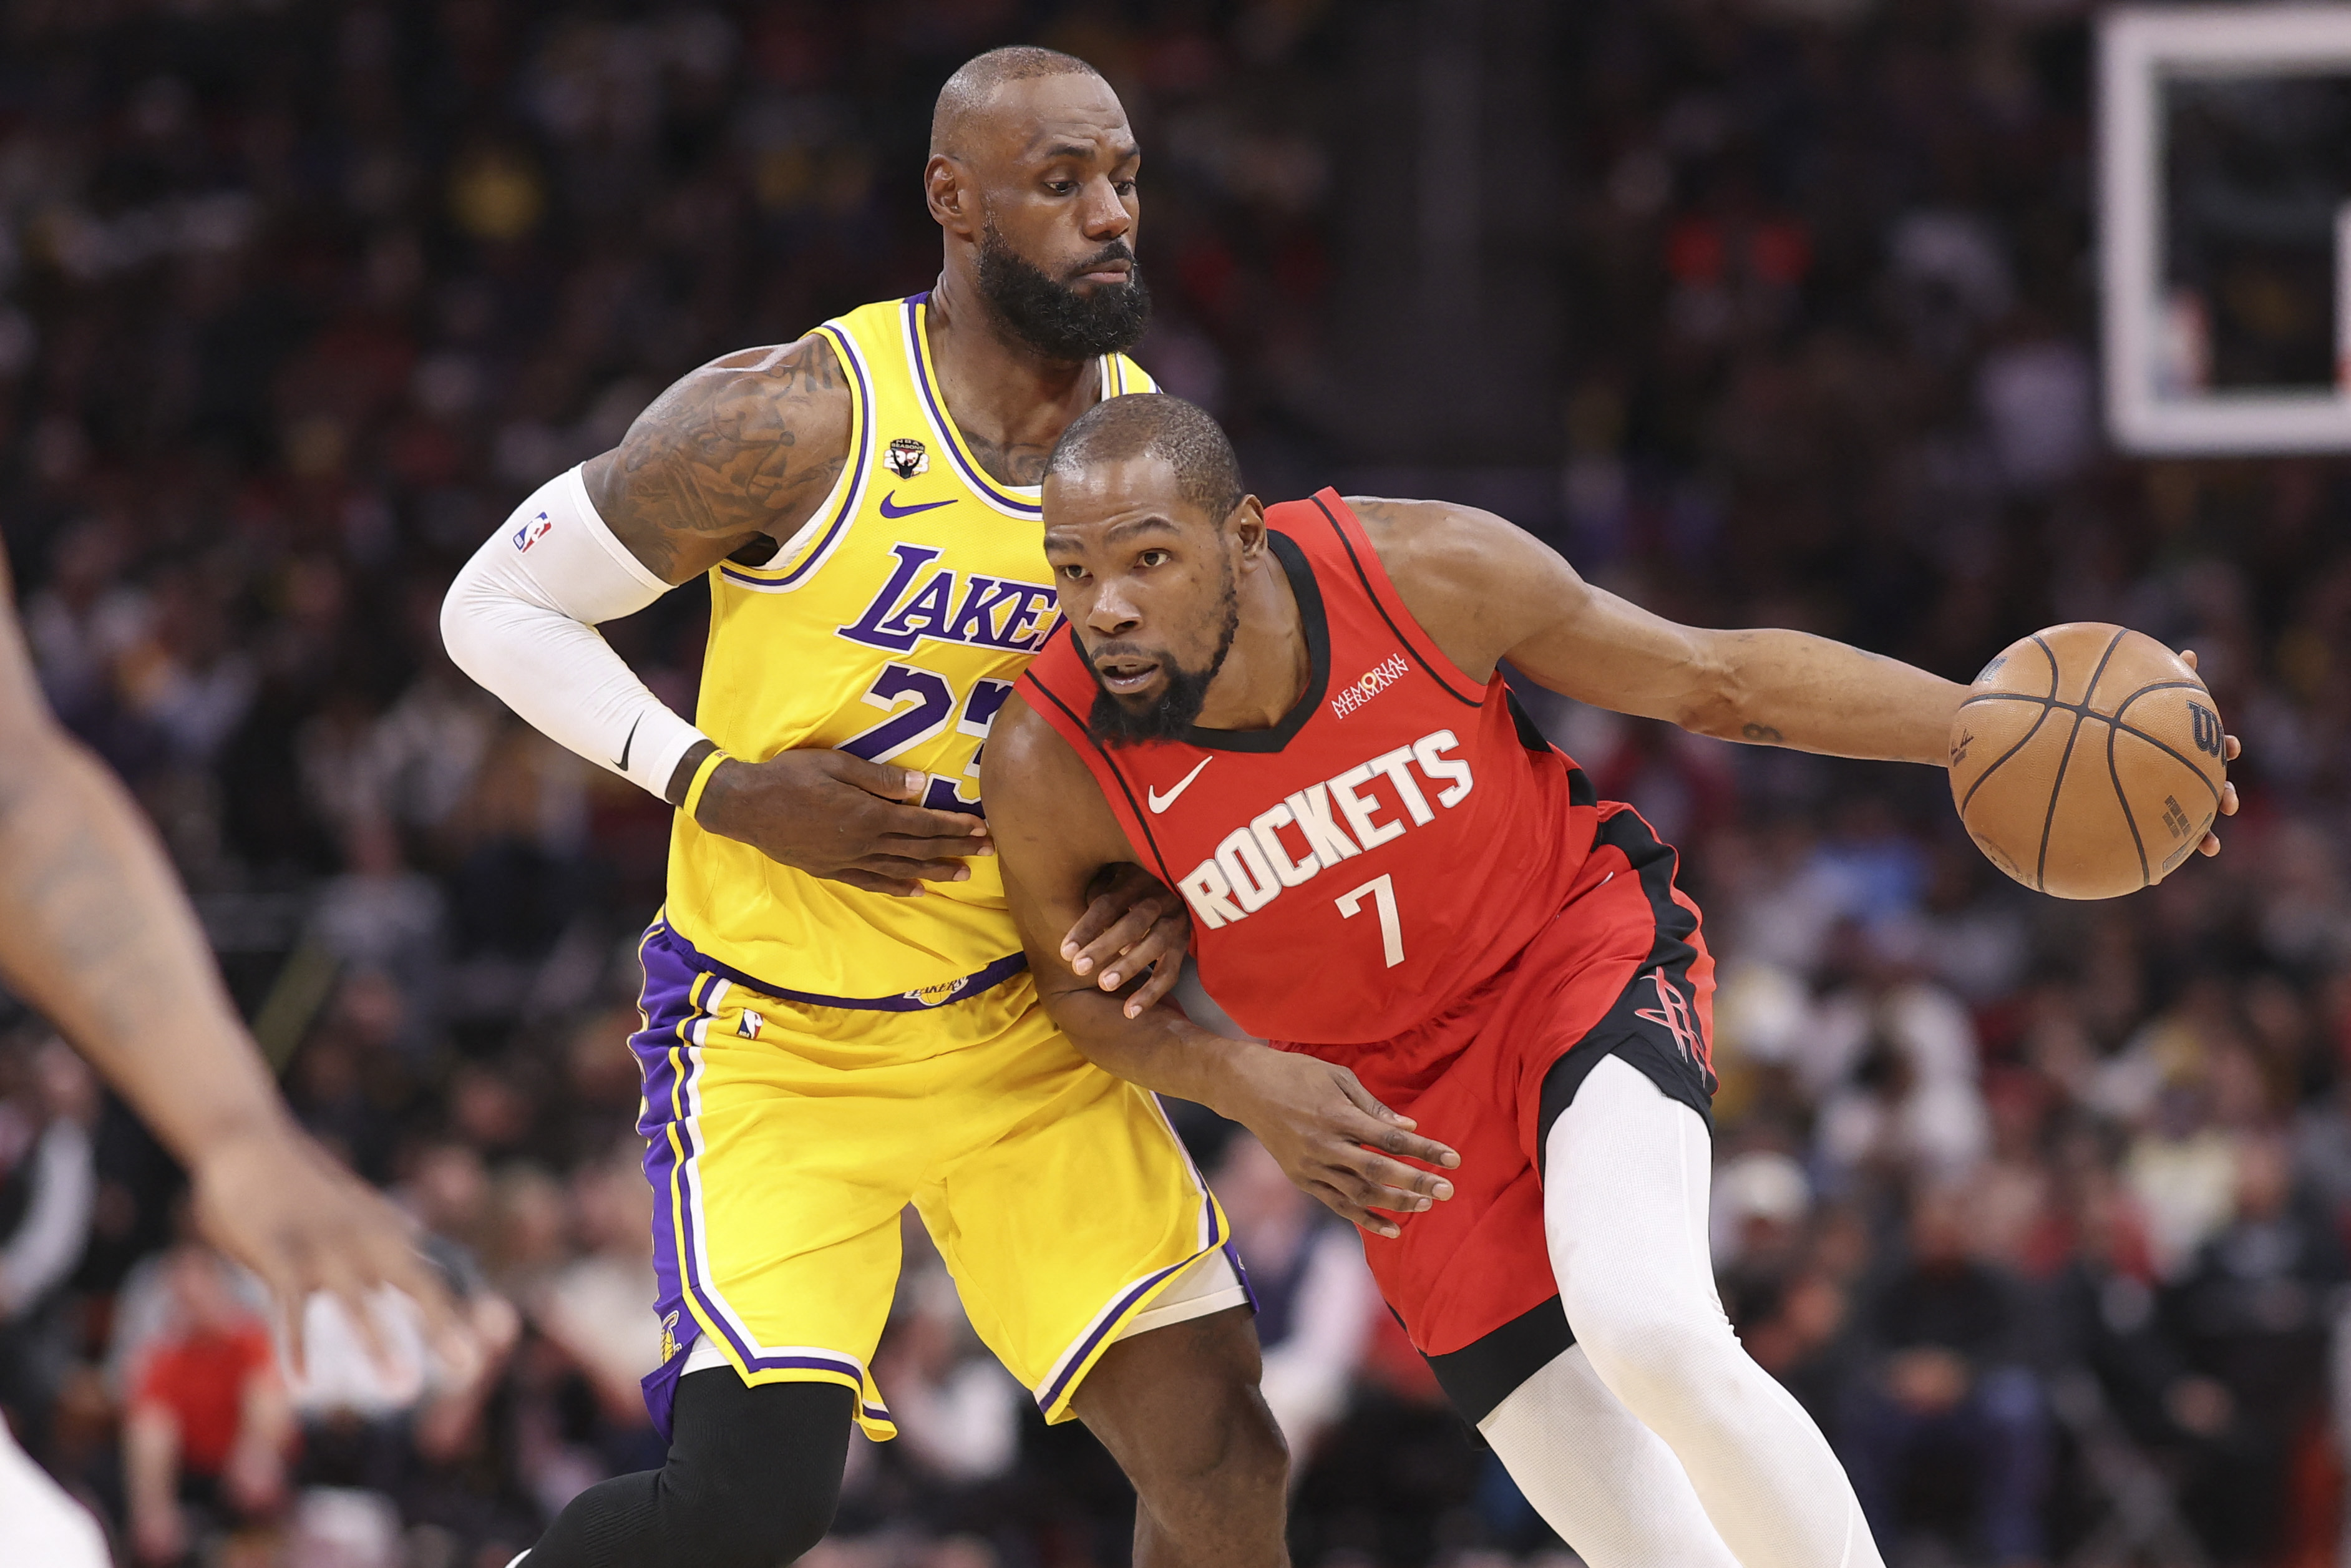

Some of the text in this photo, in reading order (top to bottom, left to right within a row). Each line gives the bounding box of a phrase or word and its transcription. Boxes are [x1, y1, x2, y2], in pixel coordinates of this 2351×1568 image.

[883, 449, 930, 473] 23
[891, 442, 924, 450] SEASONS
[834, 541, 1068, 655] LAKE
[1331, 653, 1405, 712] MEMORIAL
[1335, 661, 1409, 720] HERMANN
[1177, 729, 1474, 930] ROCKETS
[1334, 873, 1405, 968] 7
